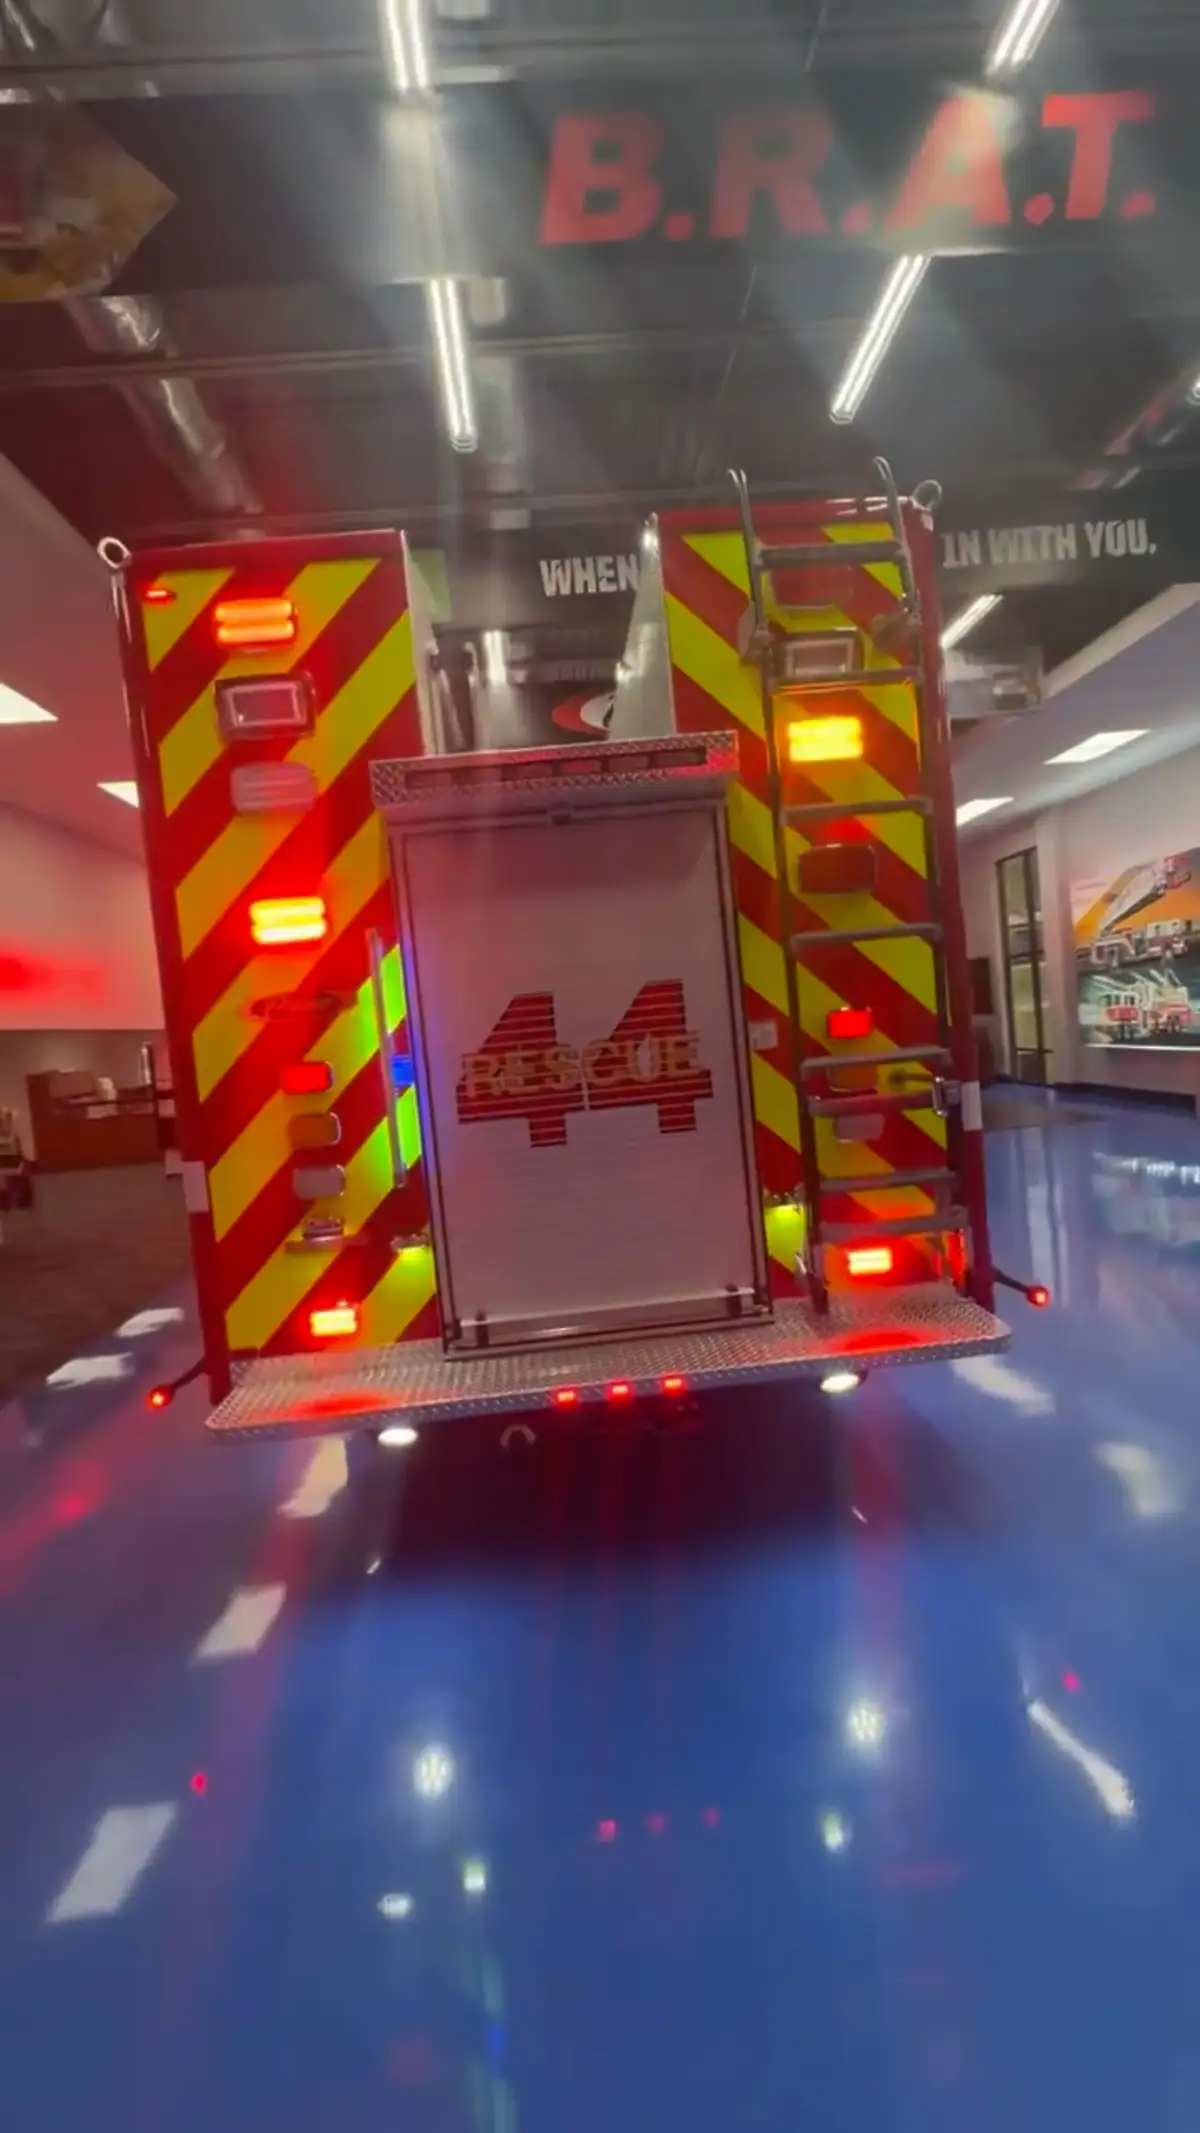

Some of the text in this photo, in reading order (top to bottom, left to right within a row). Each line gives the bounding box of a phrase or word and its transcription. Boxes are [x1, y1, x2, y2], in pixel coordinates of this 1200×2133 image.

[540, 91, 1155, 244] B.R.A.T.
[539, 553, 639, 597] WHEN
[988, 523, 1076, 565] WITH
[456, 978, 713, 1147] 44
[461, 1031, 699, 1097] RESCUE
